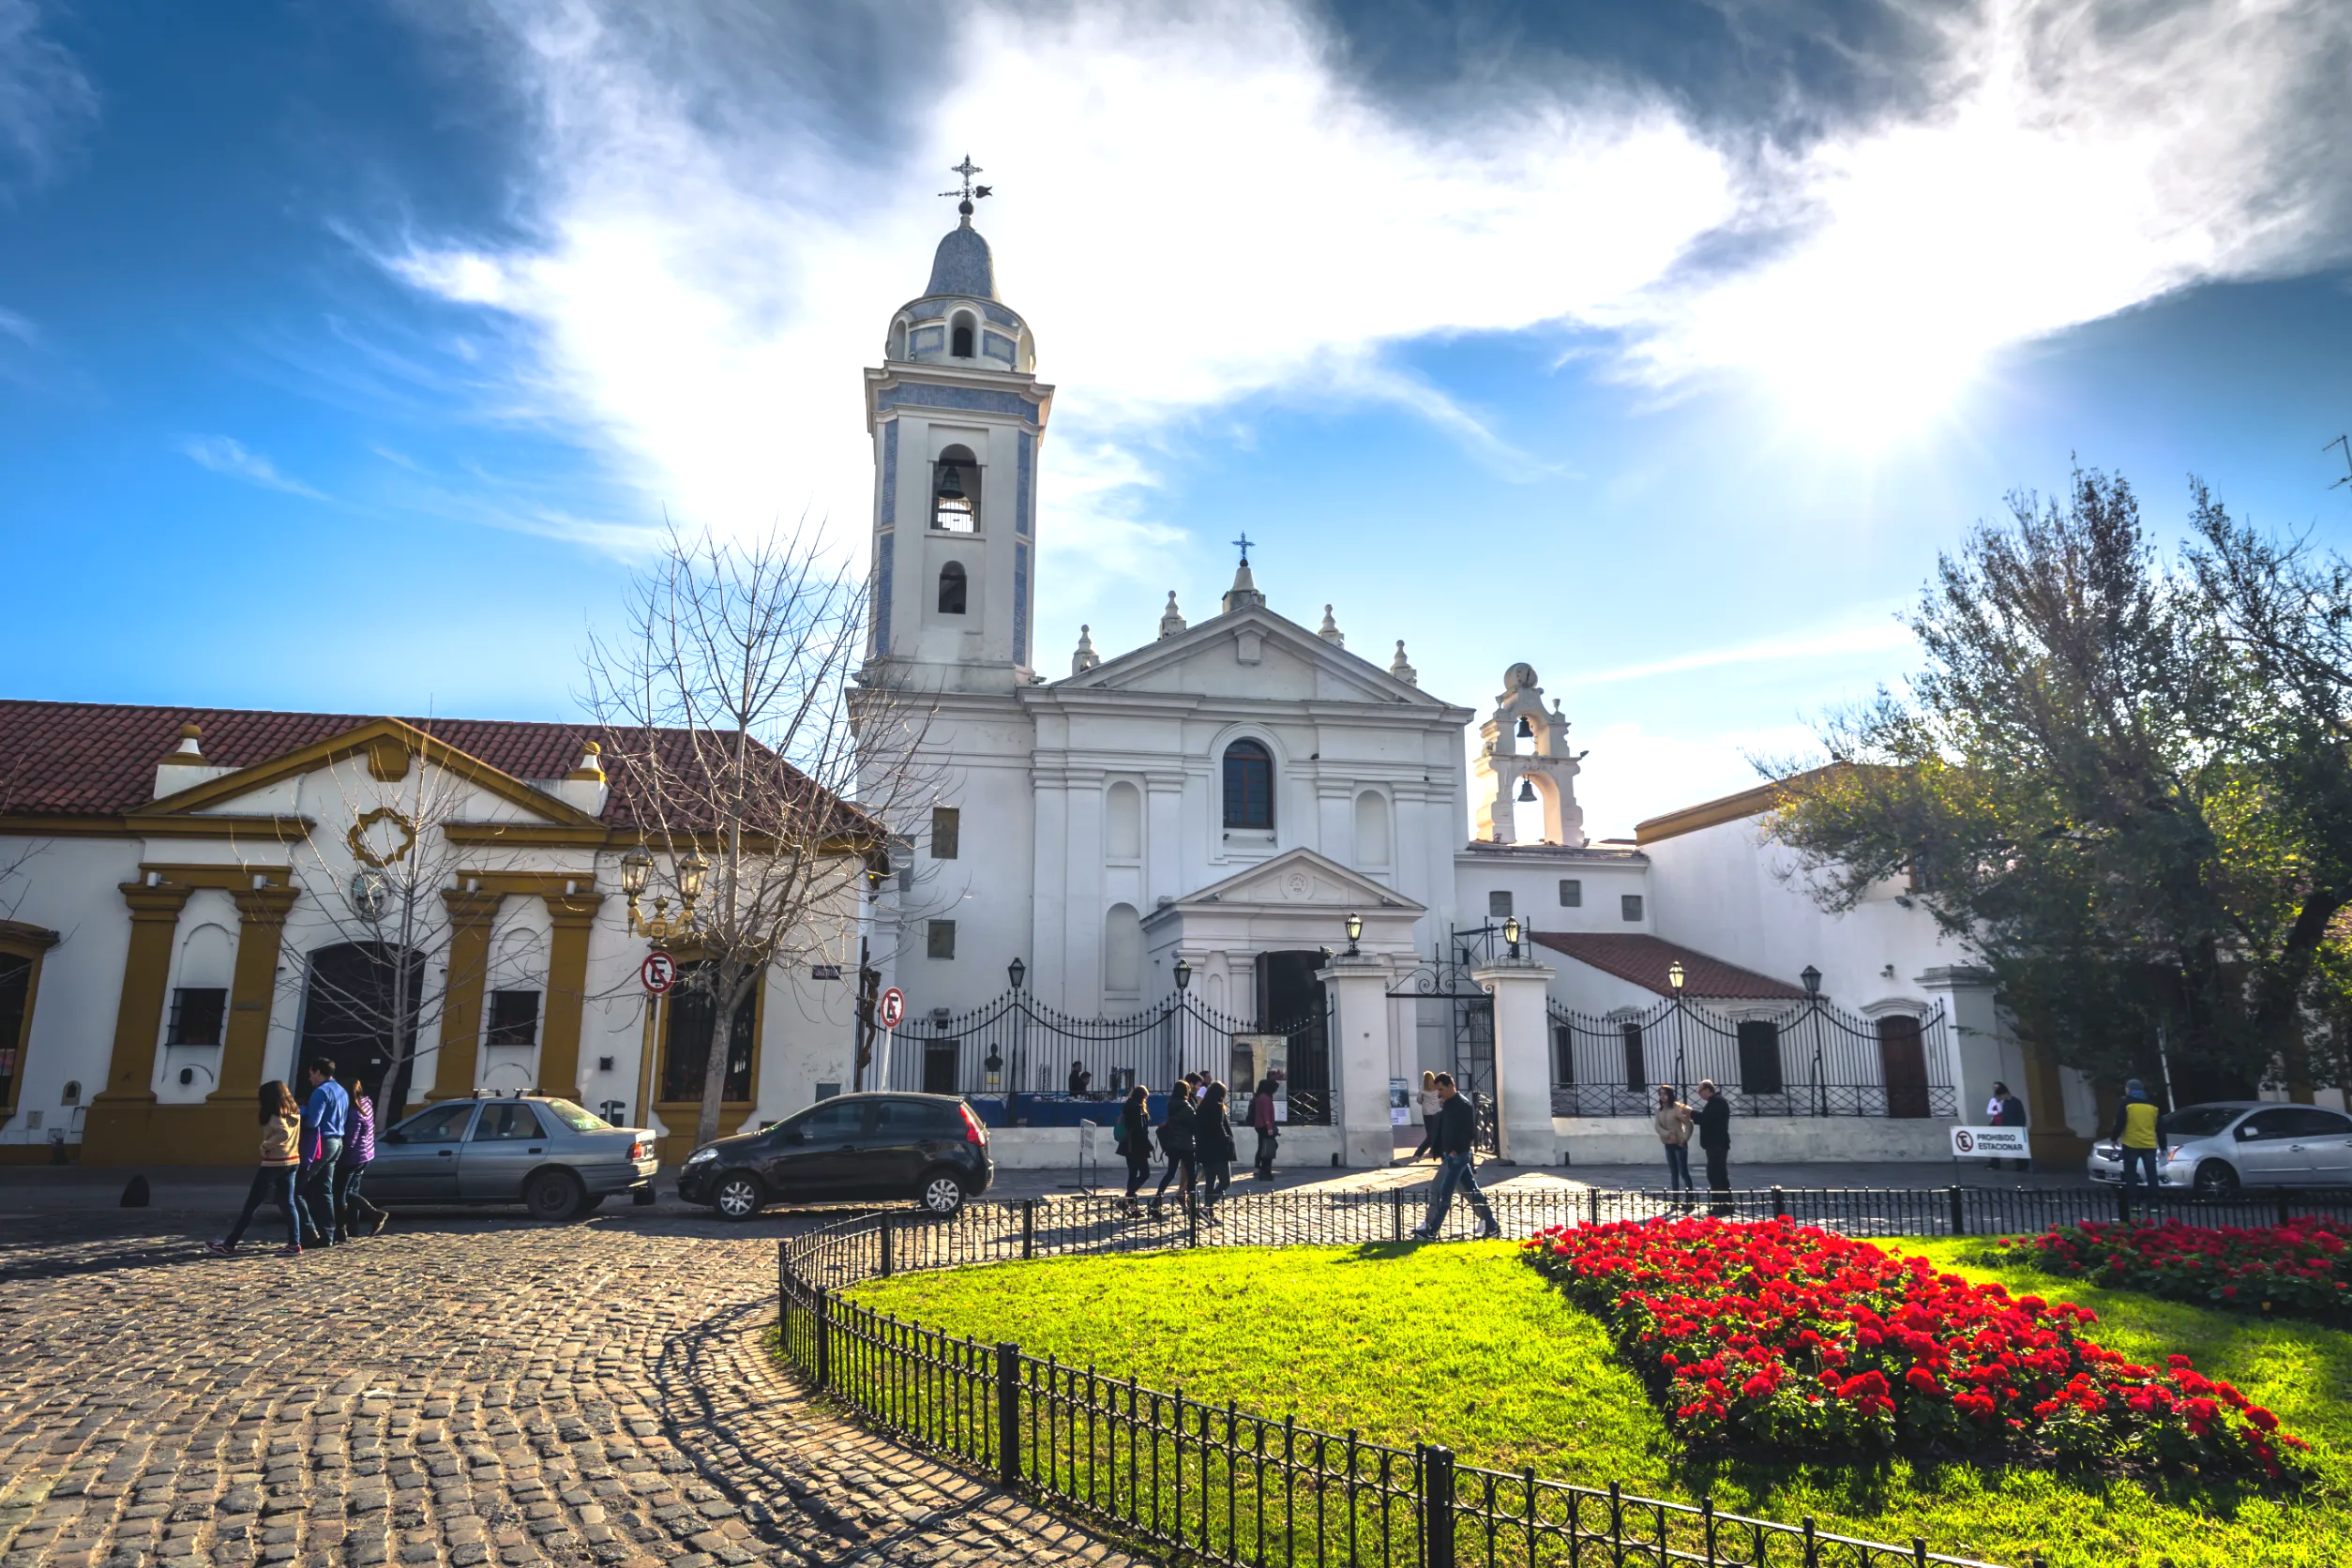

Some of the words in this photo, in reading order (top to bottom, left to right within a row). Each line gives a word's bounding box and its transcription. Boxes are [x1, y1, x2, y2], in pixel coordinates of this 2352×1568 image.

[651, 959, 667, 983] E
[886, 996, 898, 1018] E
[1976, 1133, 2016, 1141] PROHIBIDO
[1978, 1142, 2024, 1151] ESTACIONAR
